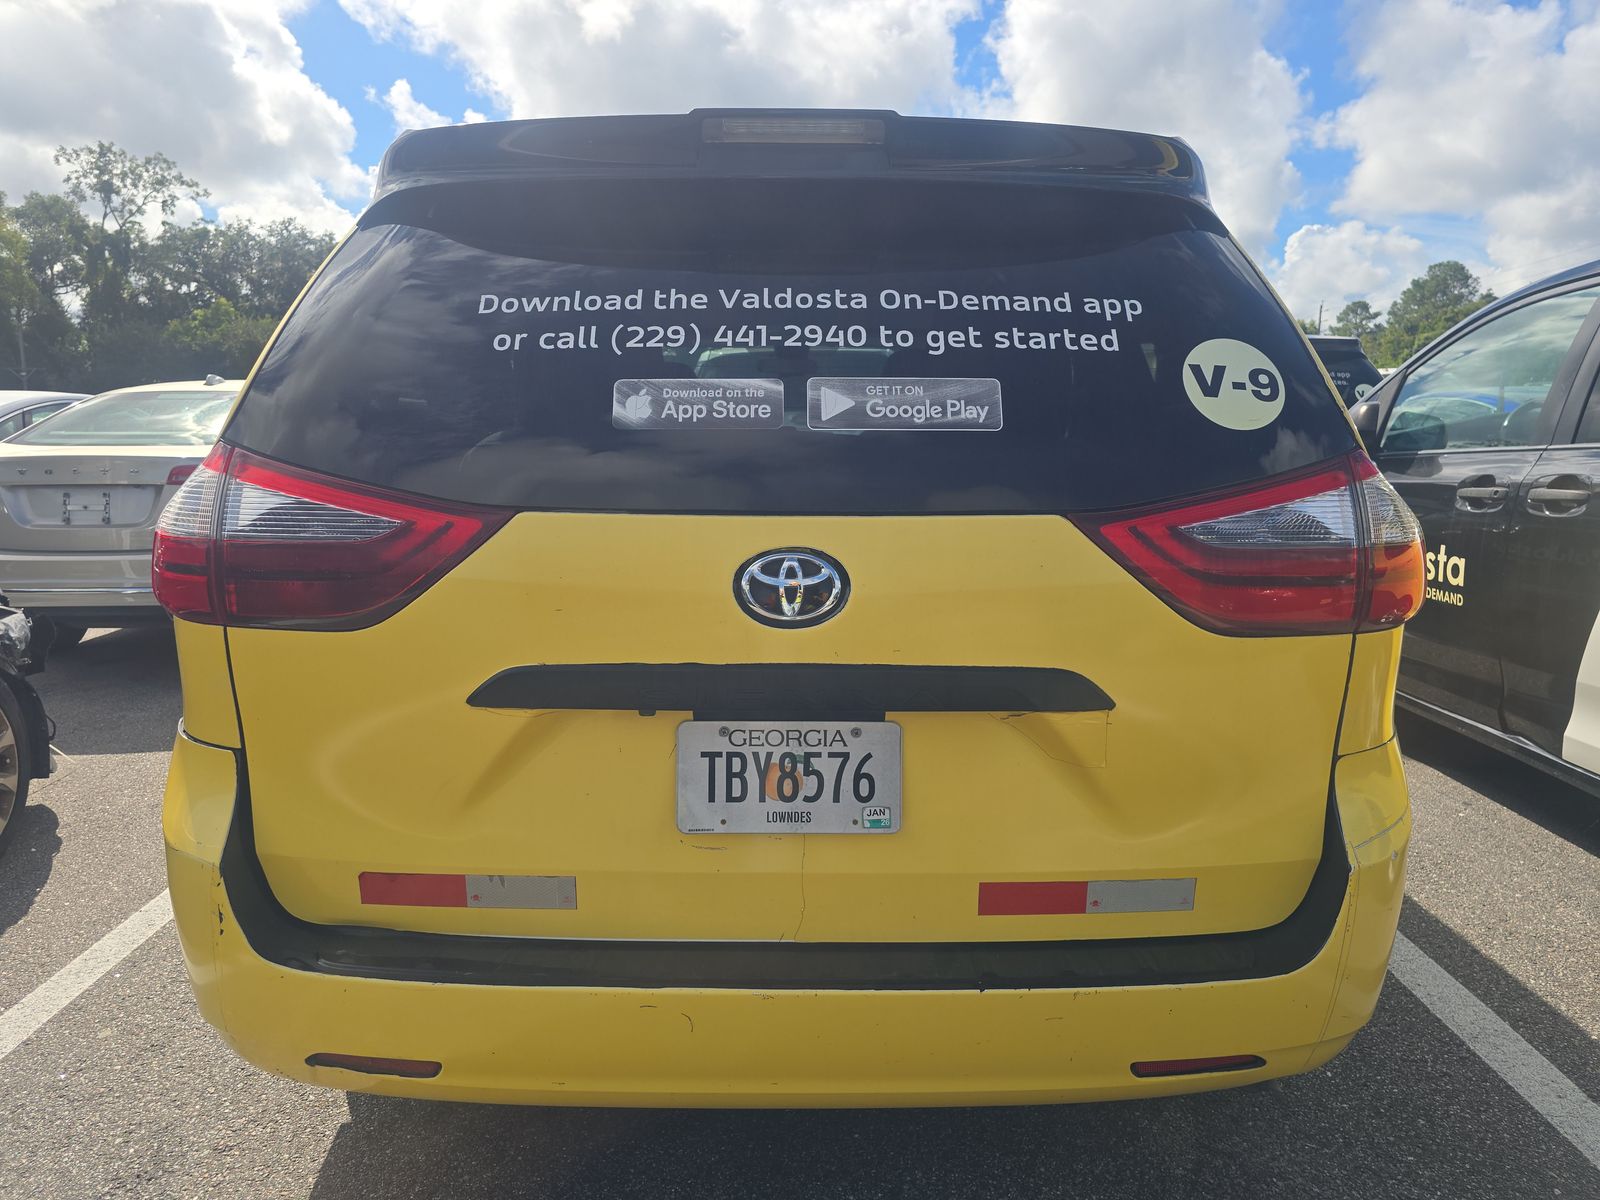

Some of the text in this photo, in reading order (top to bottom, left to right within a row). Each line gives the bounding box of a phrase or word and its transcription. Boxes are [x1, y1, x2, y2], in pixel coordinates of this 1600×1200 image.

[478, 287, 1143, 322] Download the Valdosta On-Demand app
[493, 322, 1120, 356] or call (229) 441-2940 to get started
[662, 387, 766, 399] Download on the
[866, 385, 924, 396] GET IT ON
[1187, 363, 1281, 403] V-9
[661, 400, 771, 422] App Store
[865, 399, 989, 424] Google Play
[728, 729, 848, 748] GEORGIA
[700, 751, 876, 804] TBY8576
[766, 811, 812, 823] LOWNDES
[866, 808, 886, 817] JAN
